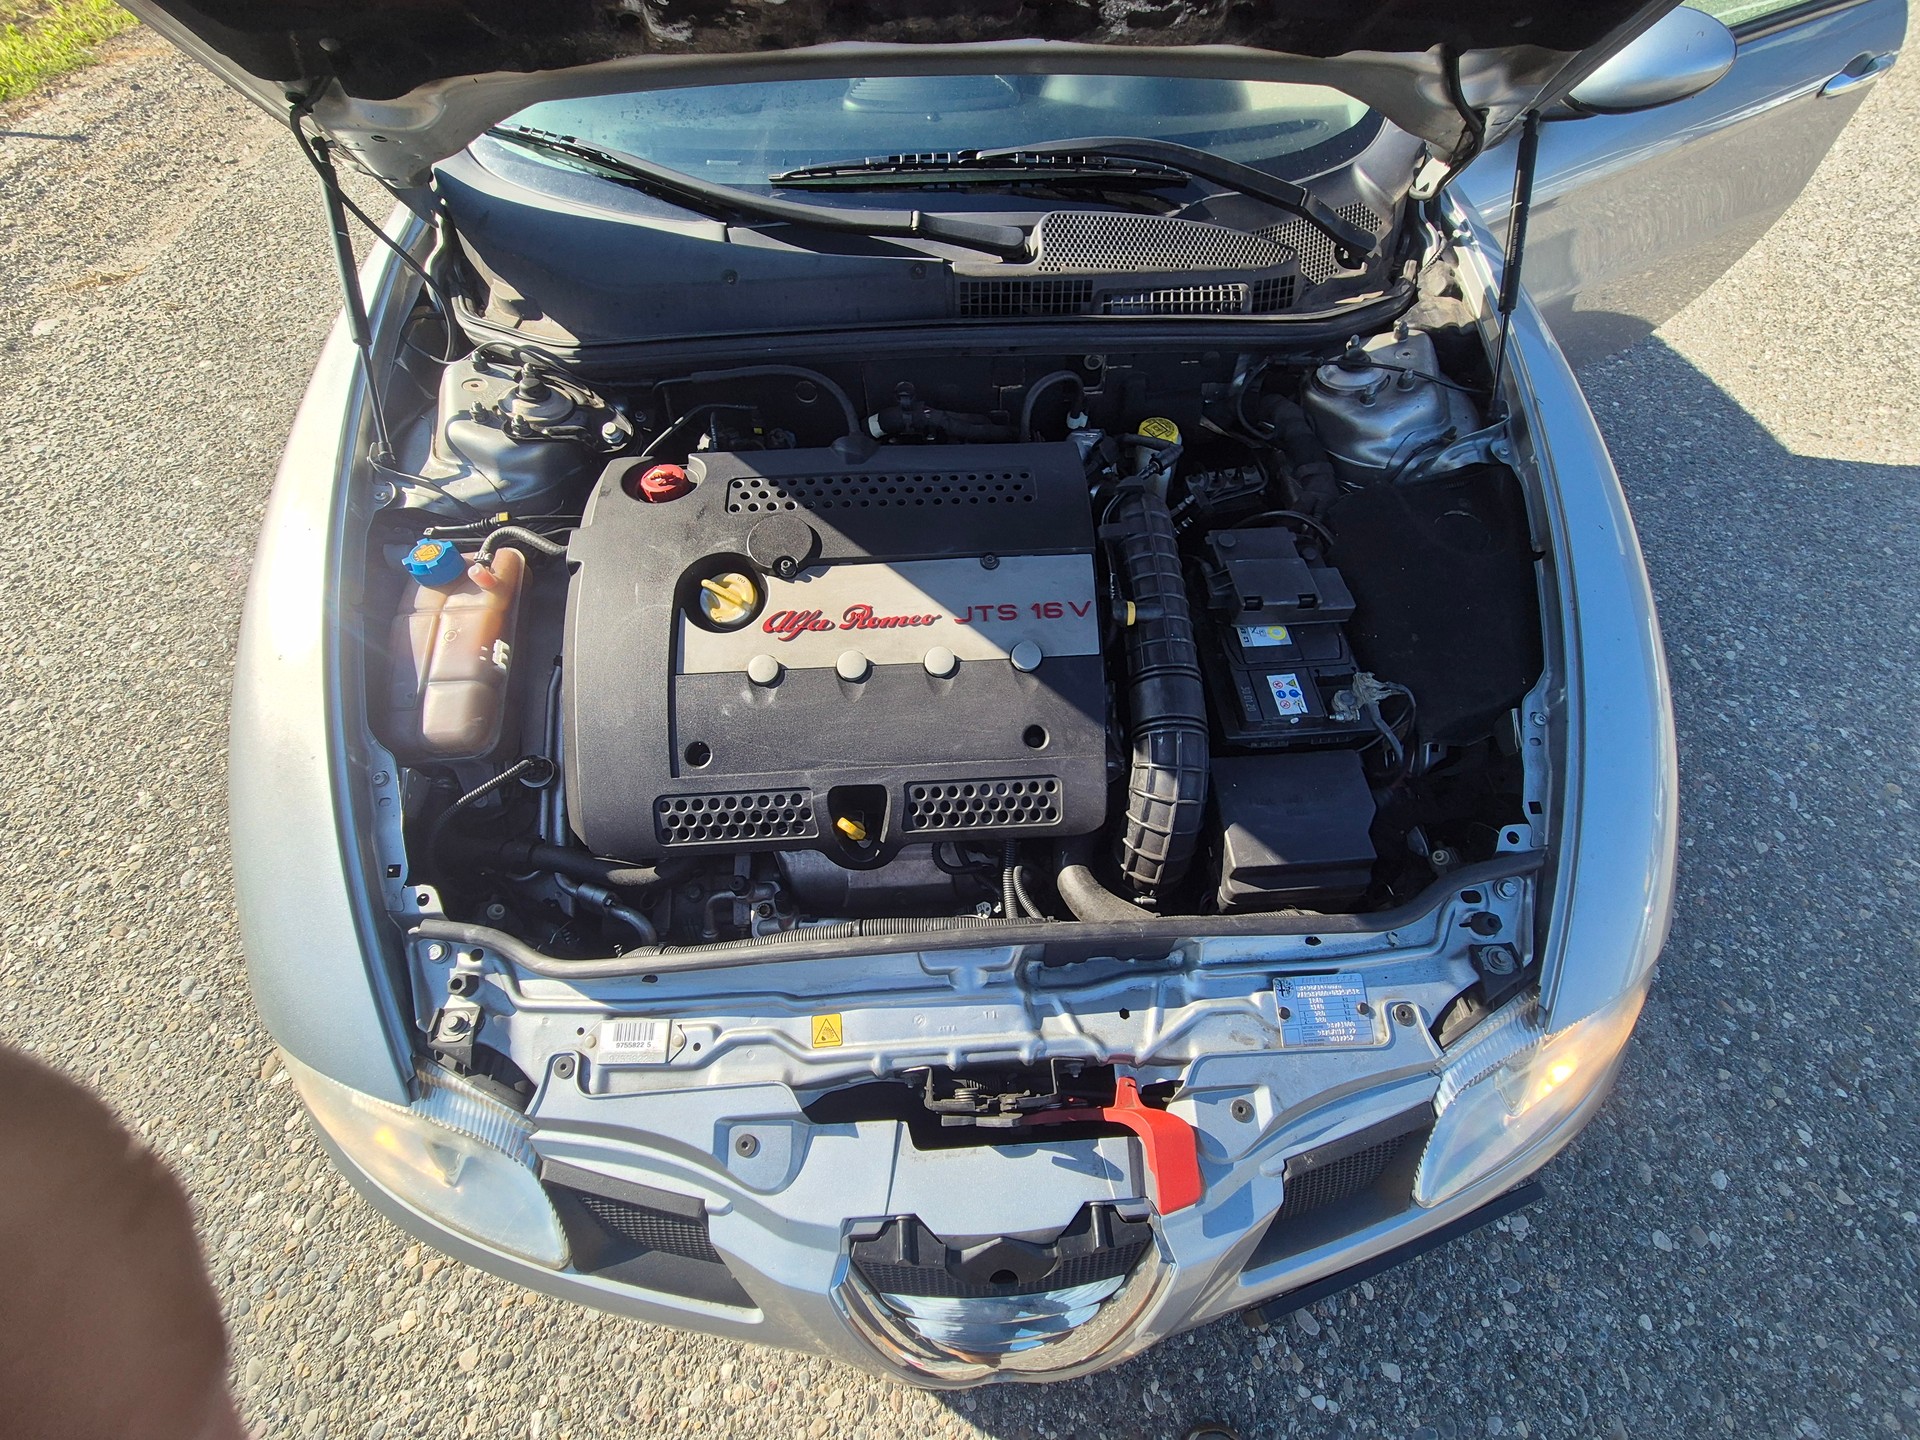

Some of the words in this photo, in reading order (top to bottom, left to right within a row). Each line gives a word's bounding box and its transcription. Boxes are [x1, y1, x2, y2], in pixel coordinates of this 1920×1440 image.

[763, 609, 835, 641] Alfa
[839, 604, 942, 630] Romeo
[954, 604, 1017, 625] JTS
